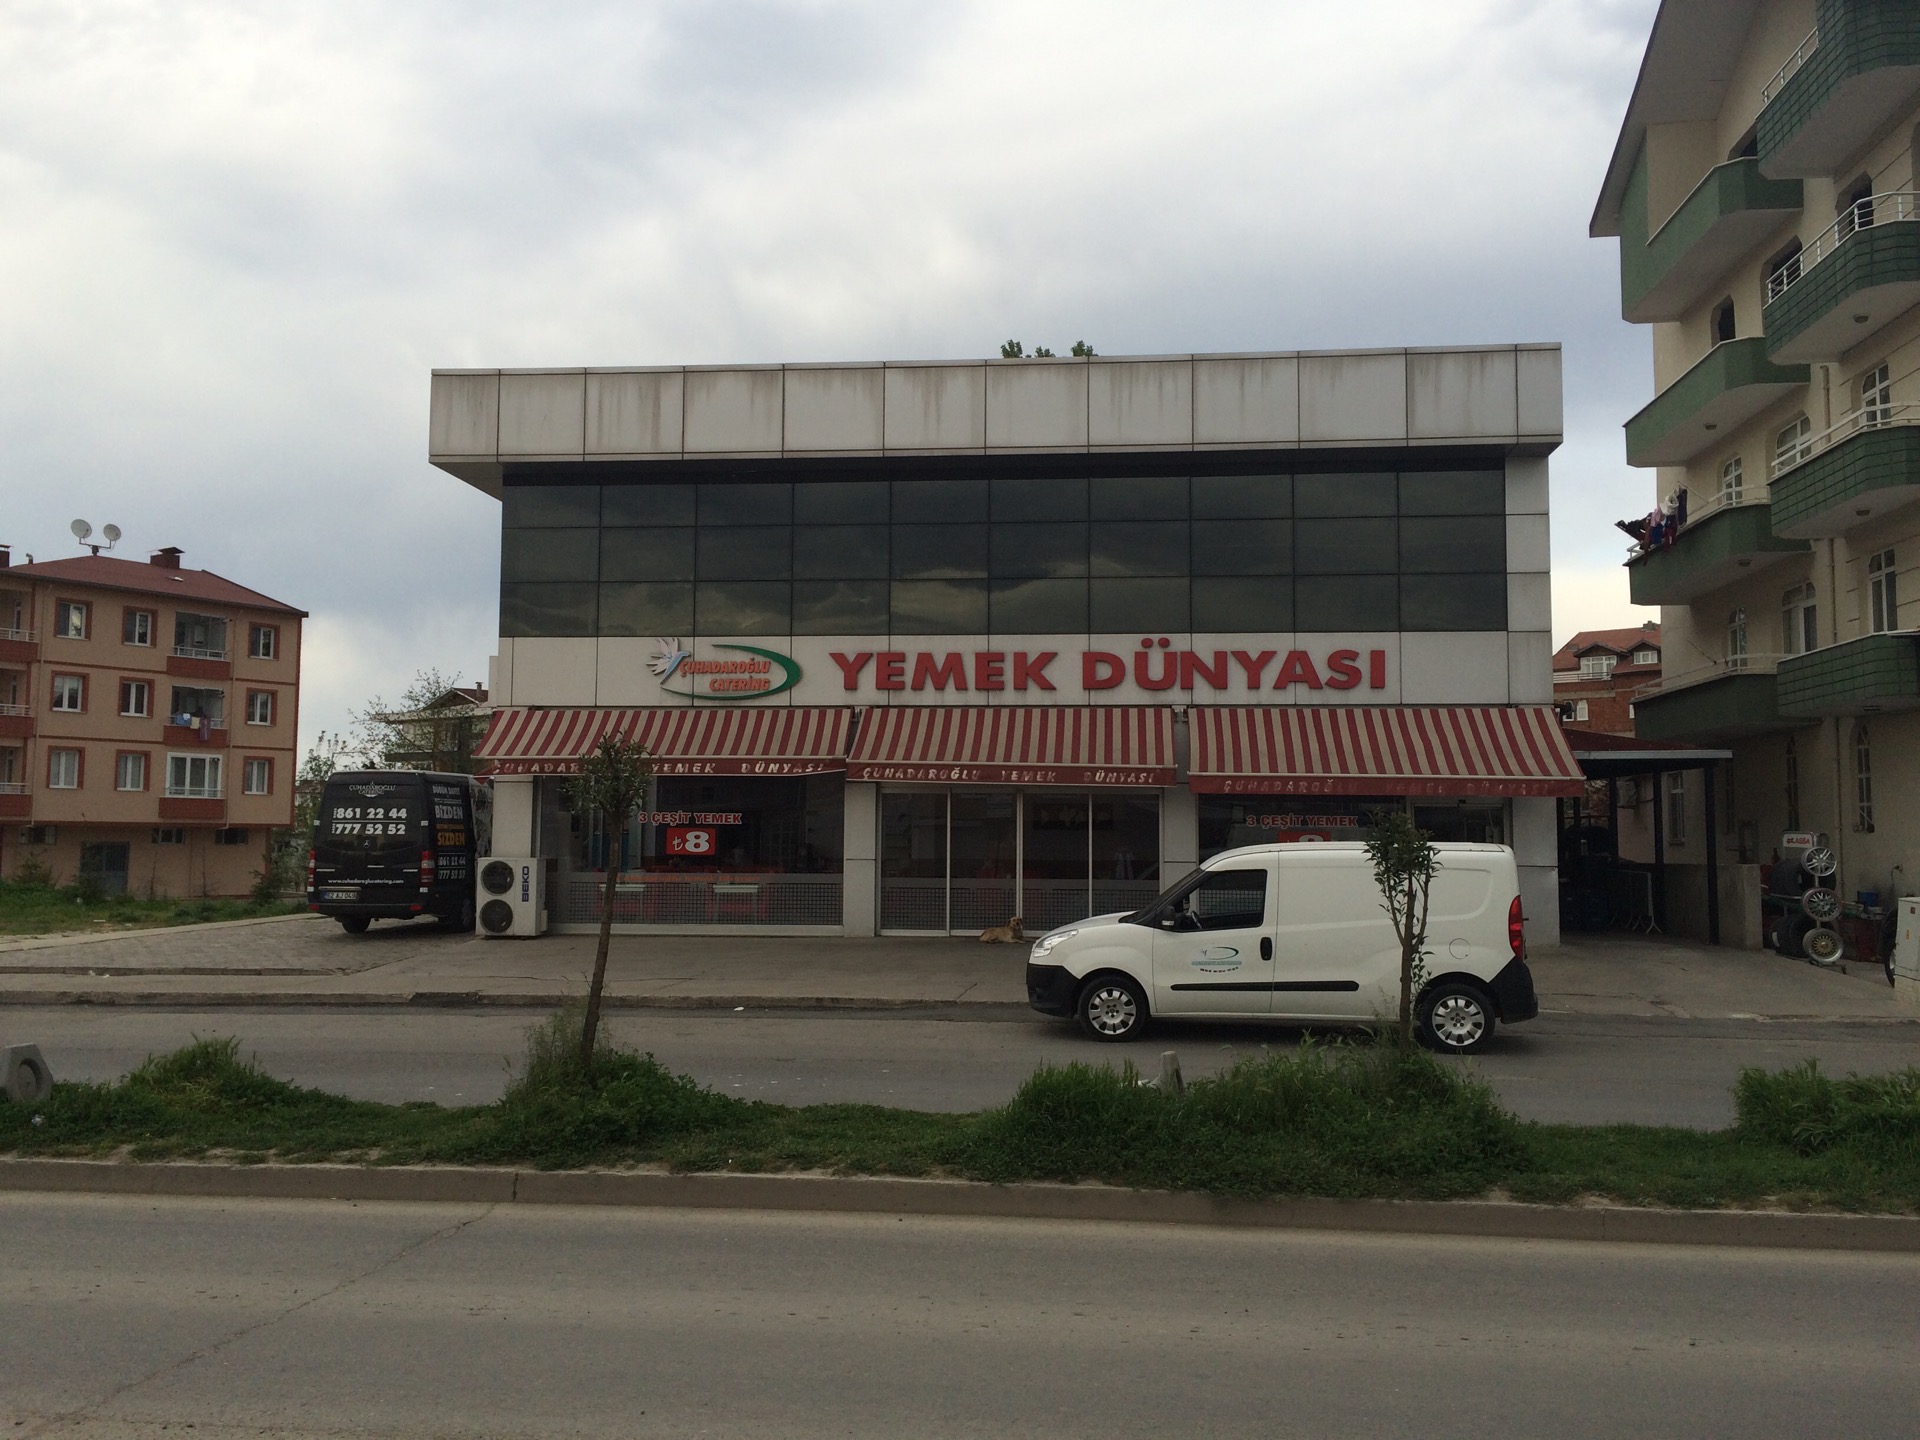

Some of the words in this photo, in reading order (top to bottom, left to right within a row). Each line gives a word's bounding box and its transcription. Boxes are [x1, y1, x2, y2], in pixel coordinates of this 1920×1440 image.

[679, 657, 771, 677] ÇUHADAROĞLU
[829, 652, 1057, 690] YEMEK
[1082, 637, 1386, 690] DÜNYASI
[709, 675, 770, 691] CATERİNG
[651, 763, 716, 773] YEMEK
[336, 808, 361, 819] 861
[366, 808, 385, 819] 22
[388, 808, 407, 819] 44
[638, 812, 649, 824] 3
[651, 810, 692, 826] ÇEŞİT
[694, 813, 743, 825] YEMEK
[1246, 815, 1256, 827] 3
[1260, 813, 1303, 830] ÇEŞİT
[1306, 816, 1358, 828] YEMEK
[335, 823, 361, 834] 777
[365, 823, 383, 834] 52
[387, 823, 406, 834] 52
[521, 866, 530, 902] BEKO
